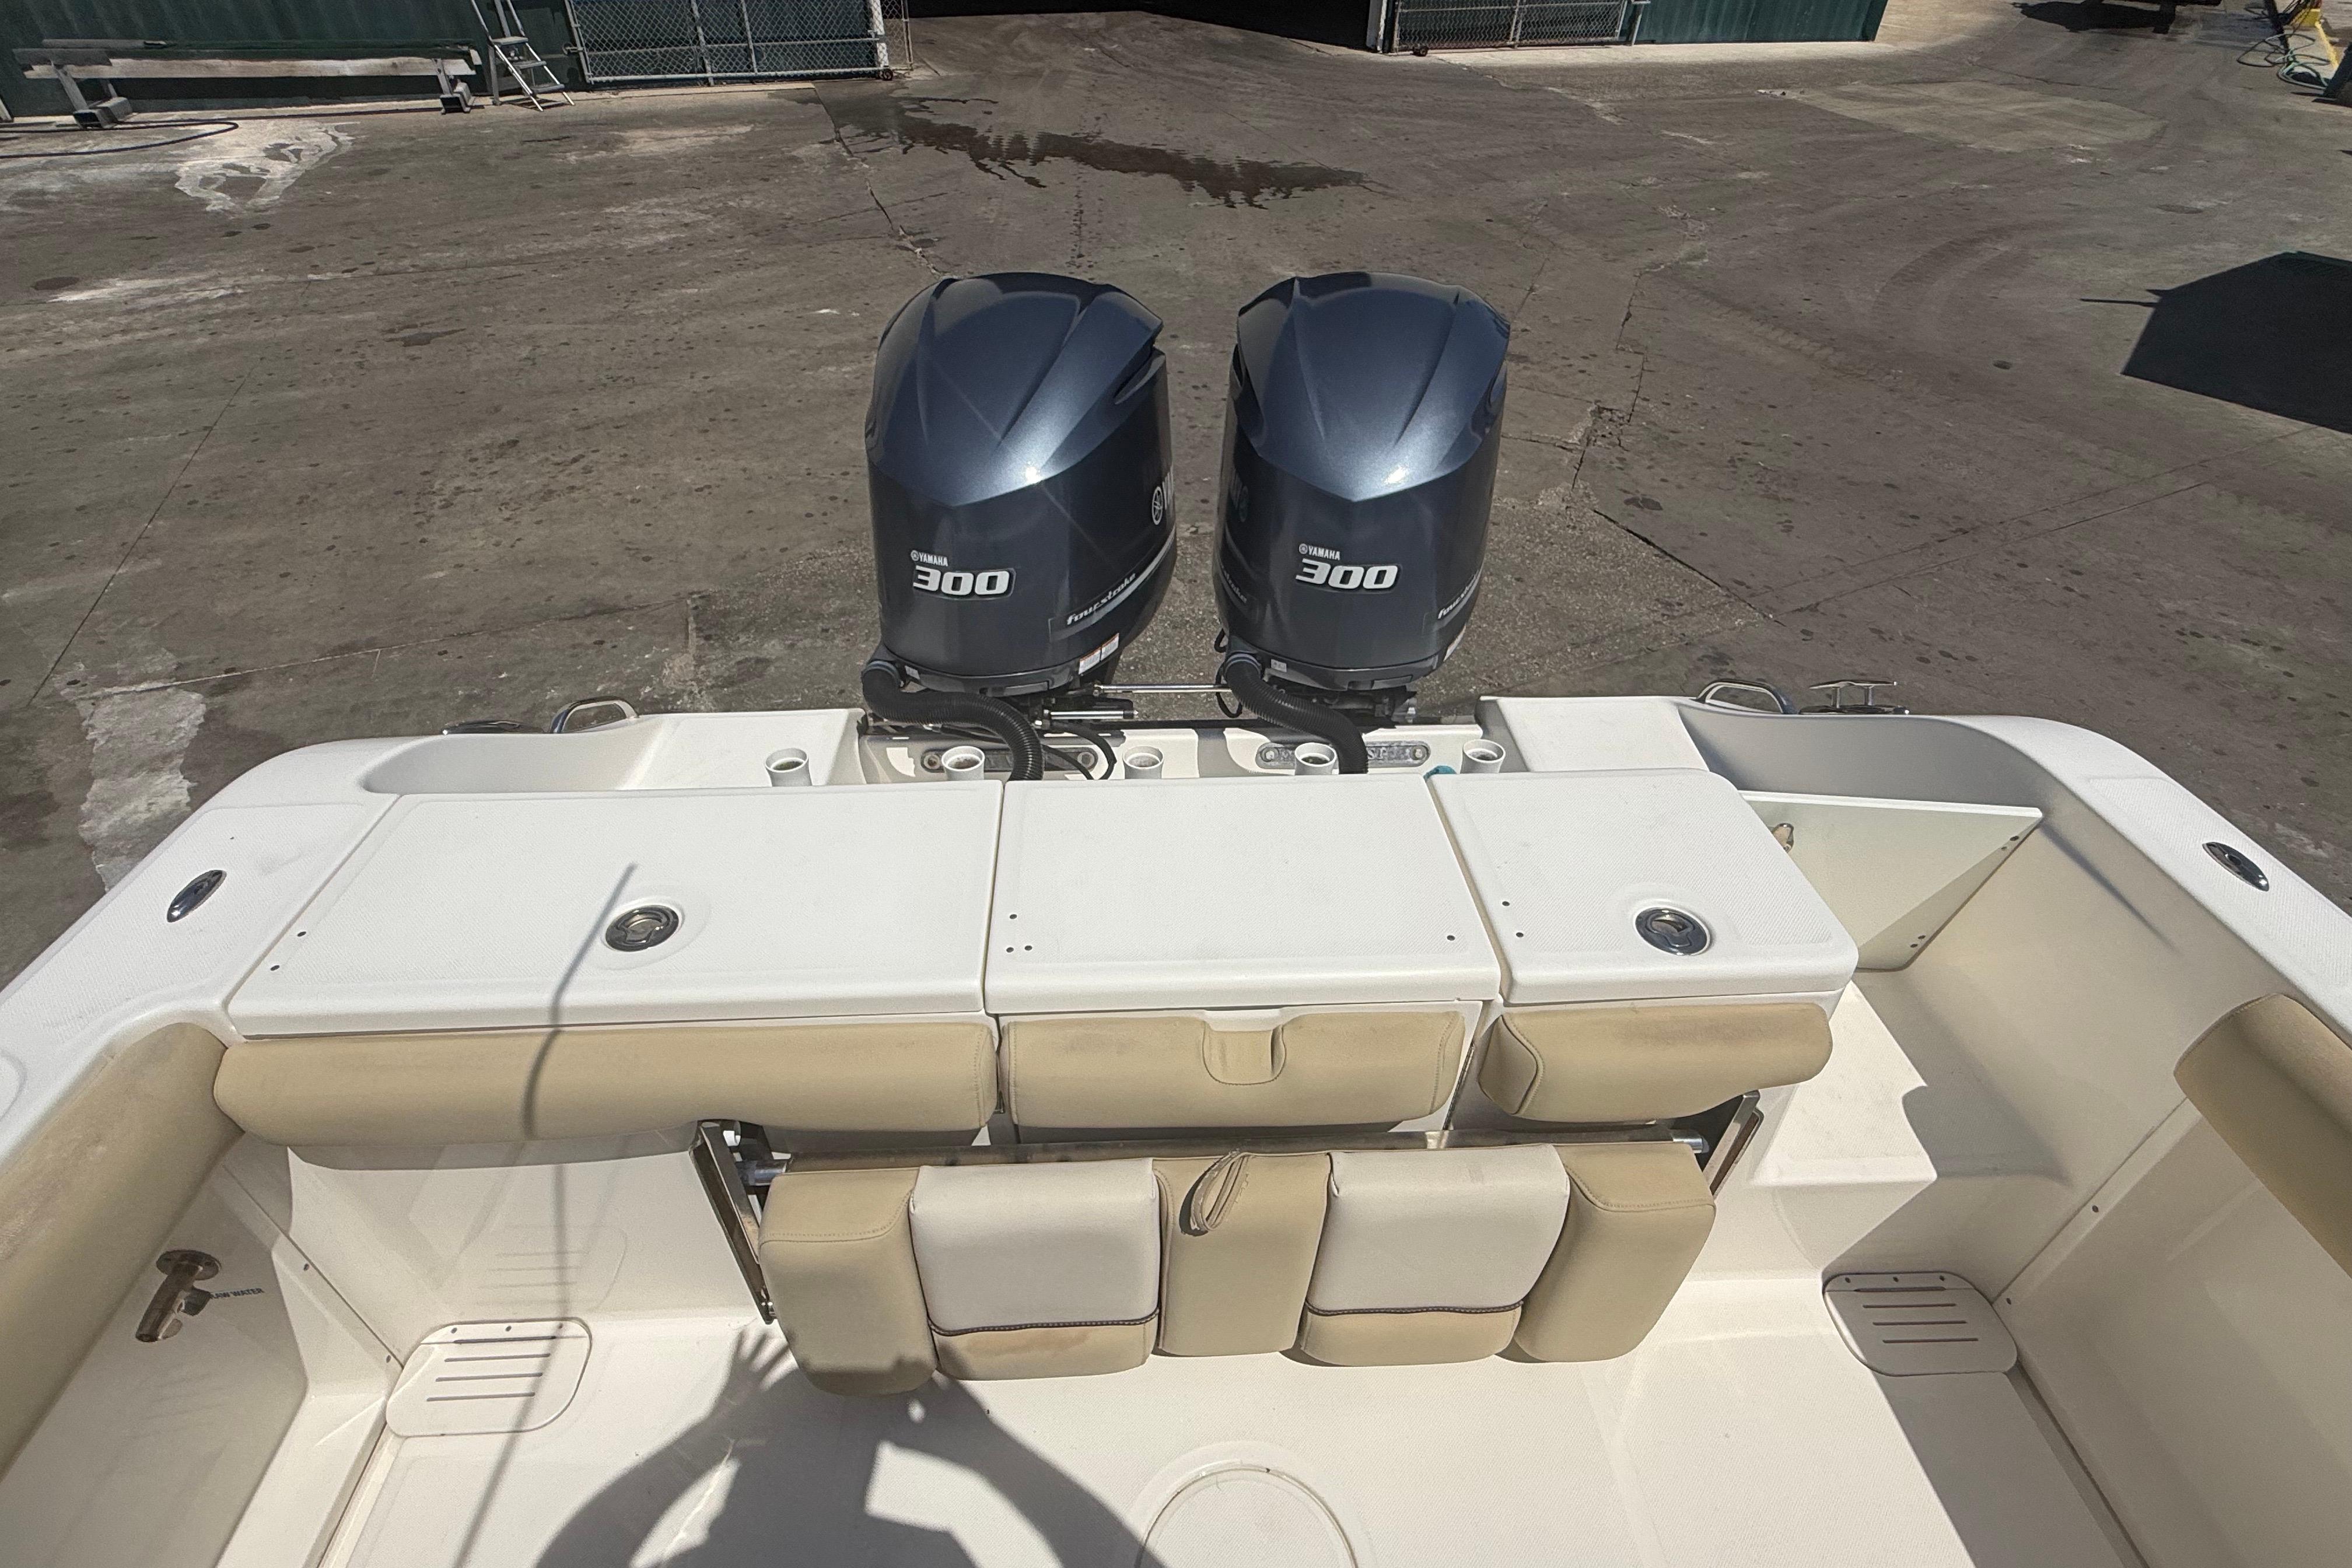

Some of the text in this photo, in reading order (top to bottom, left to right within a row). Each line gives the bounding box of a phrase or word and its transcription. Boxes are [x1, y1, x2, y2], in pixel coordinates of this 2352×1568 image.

[919, 553, 949, 567] YAMAHA
[1308, 545, 1340, 561] YAMAHA
[912, 565, 1010, 596] 300
[1295, 558, 1398, 589] 300
[230, 1287, 265, 1297] WATER
